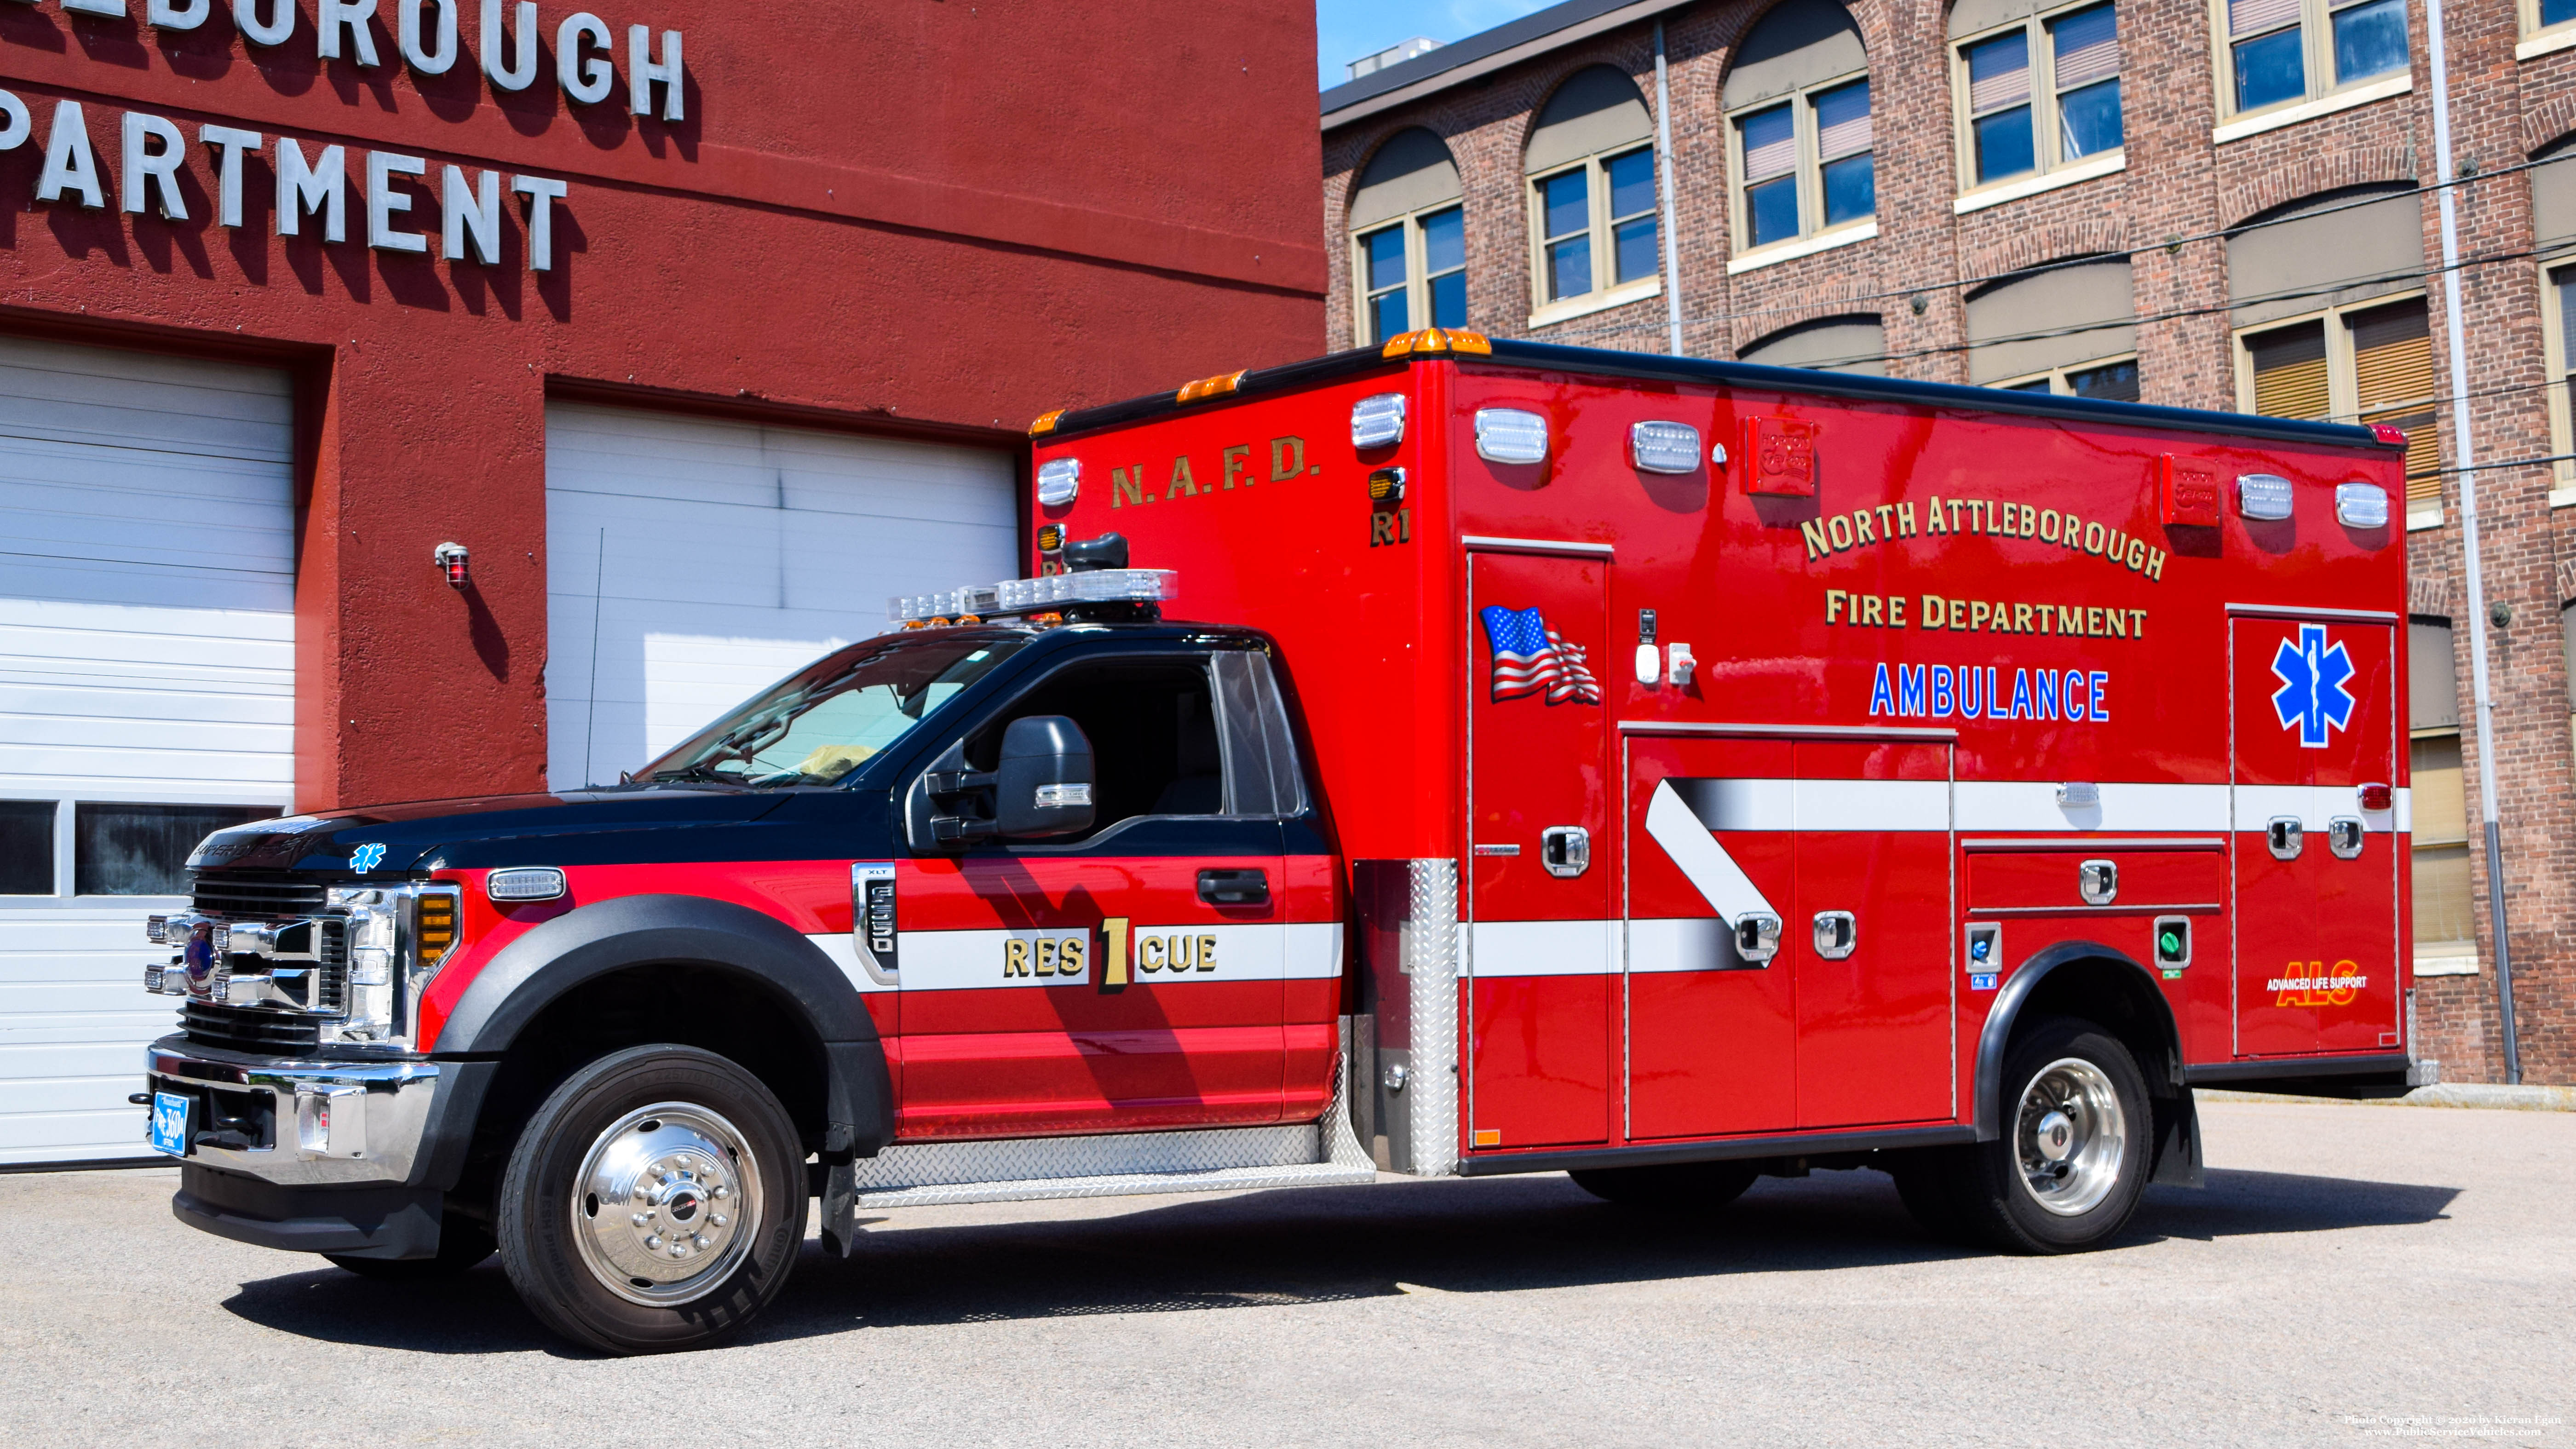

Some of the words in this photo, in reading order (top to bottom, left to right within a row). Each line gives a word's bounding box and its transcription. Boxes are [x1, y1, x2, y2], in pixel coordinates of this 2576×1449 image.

[0, 0, 684, 121] ROUGH
[1370, 508, 1411, 547] R1
[1801, 501, 1917, 563] NORTH
[1927, 495, 2166, 582] ATTLEBOROUGH
[1826, 589, 1906, 628] FIRE
[1921, 595, 2148, 639] DEPARTMENT
[1869, 662, 2109, 722] AMBULANCE
[1004, 937, 1084, 978] RES
[1098, 917, 1129, 993] 1
[1139, 934, 1217, 973] CUE
[2267, 978, 2310, 991] ADVANCED
[2312, 977, 2328, 989] LIFE
[2329, 976, 2367, 989] SUPPORT
[2276, 960, 2358, 1006] ALS
